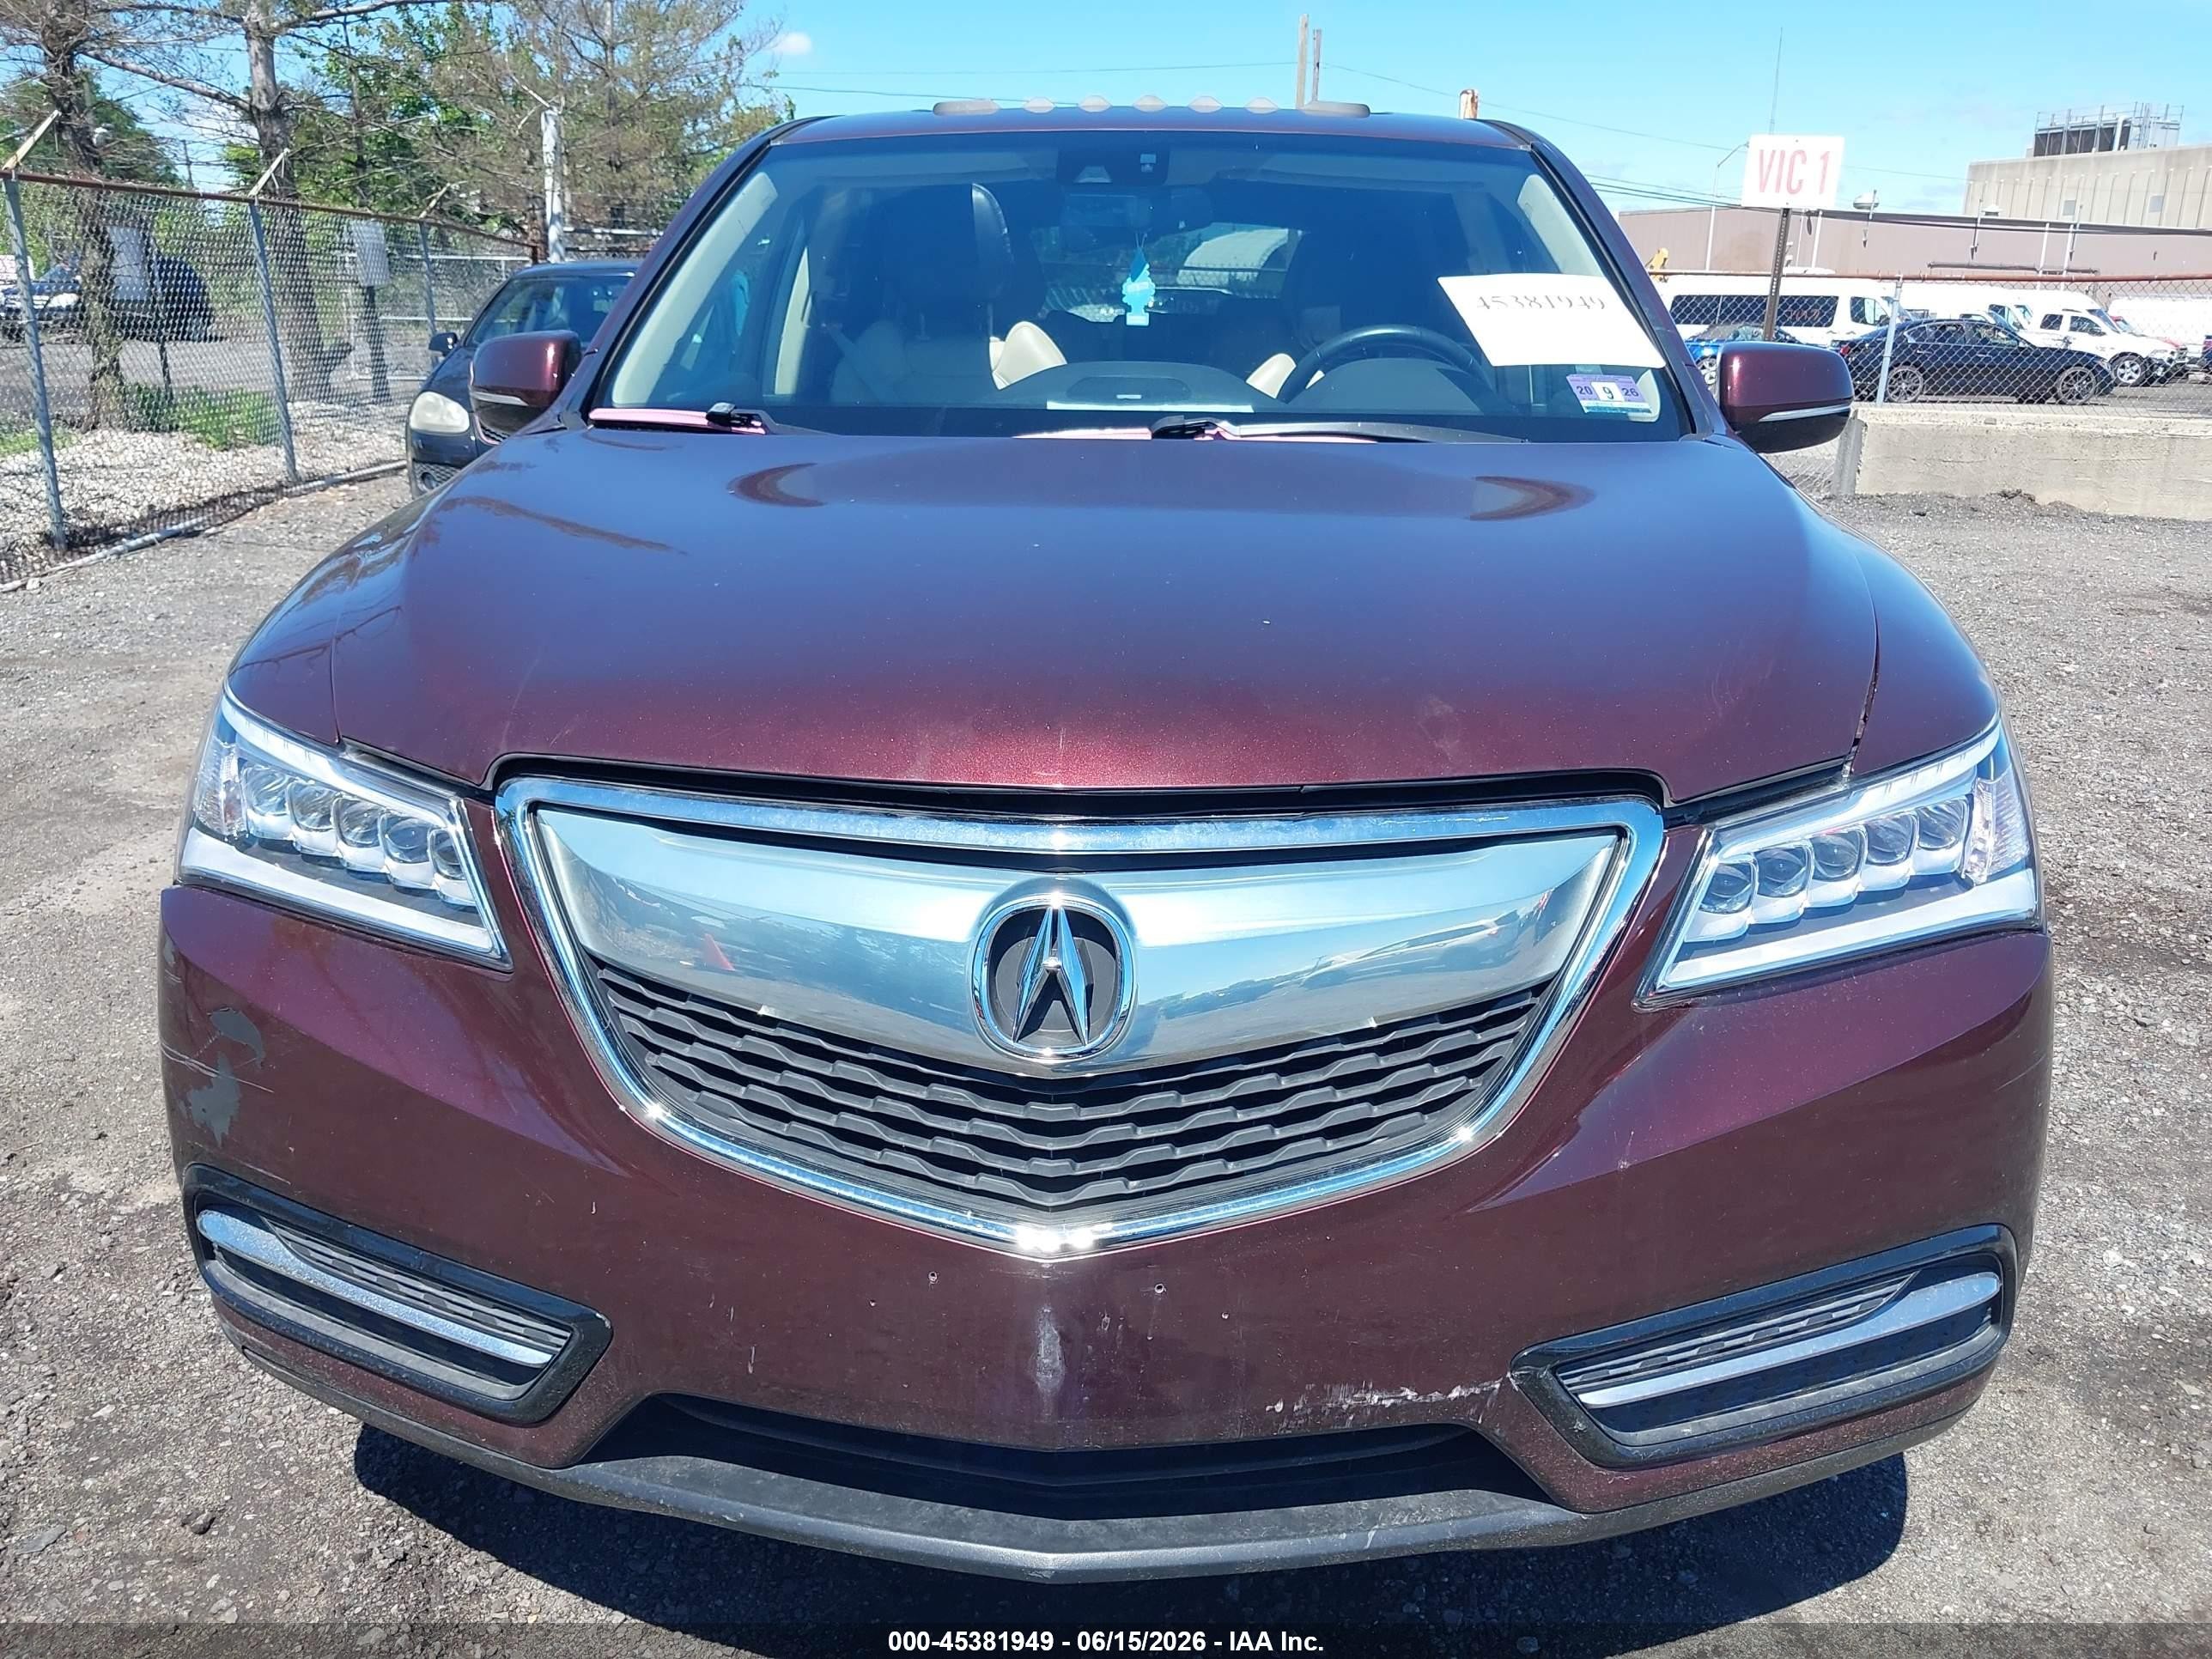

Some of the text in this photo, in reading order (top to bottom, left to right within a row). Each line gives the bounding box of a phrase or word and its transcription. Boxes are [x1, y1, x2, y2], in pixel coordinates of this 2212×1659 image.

[1758, 149, 1831, 195] VIC 1
[1576, 385, 1640, 400] 20 9 26
